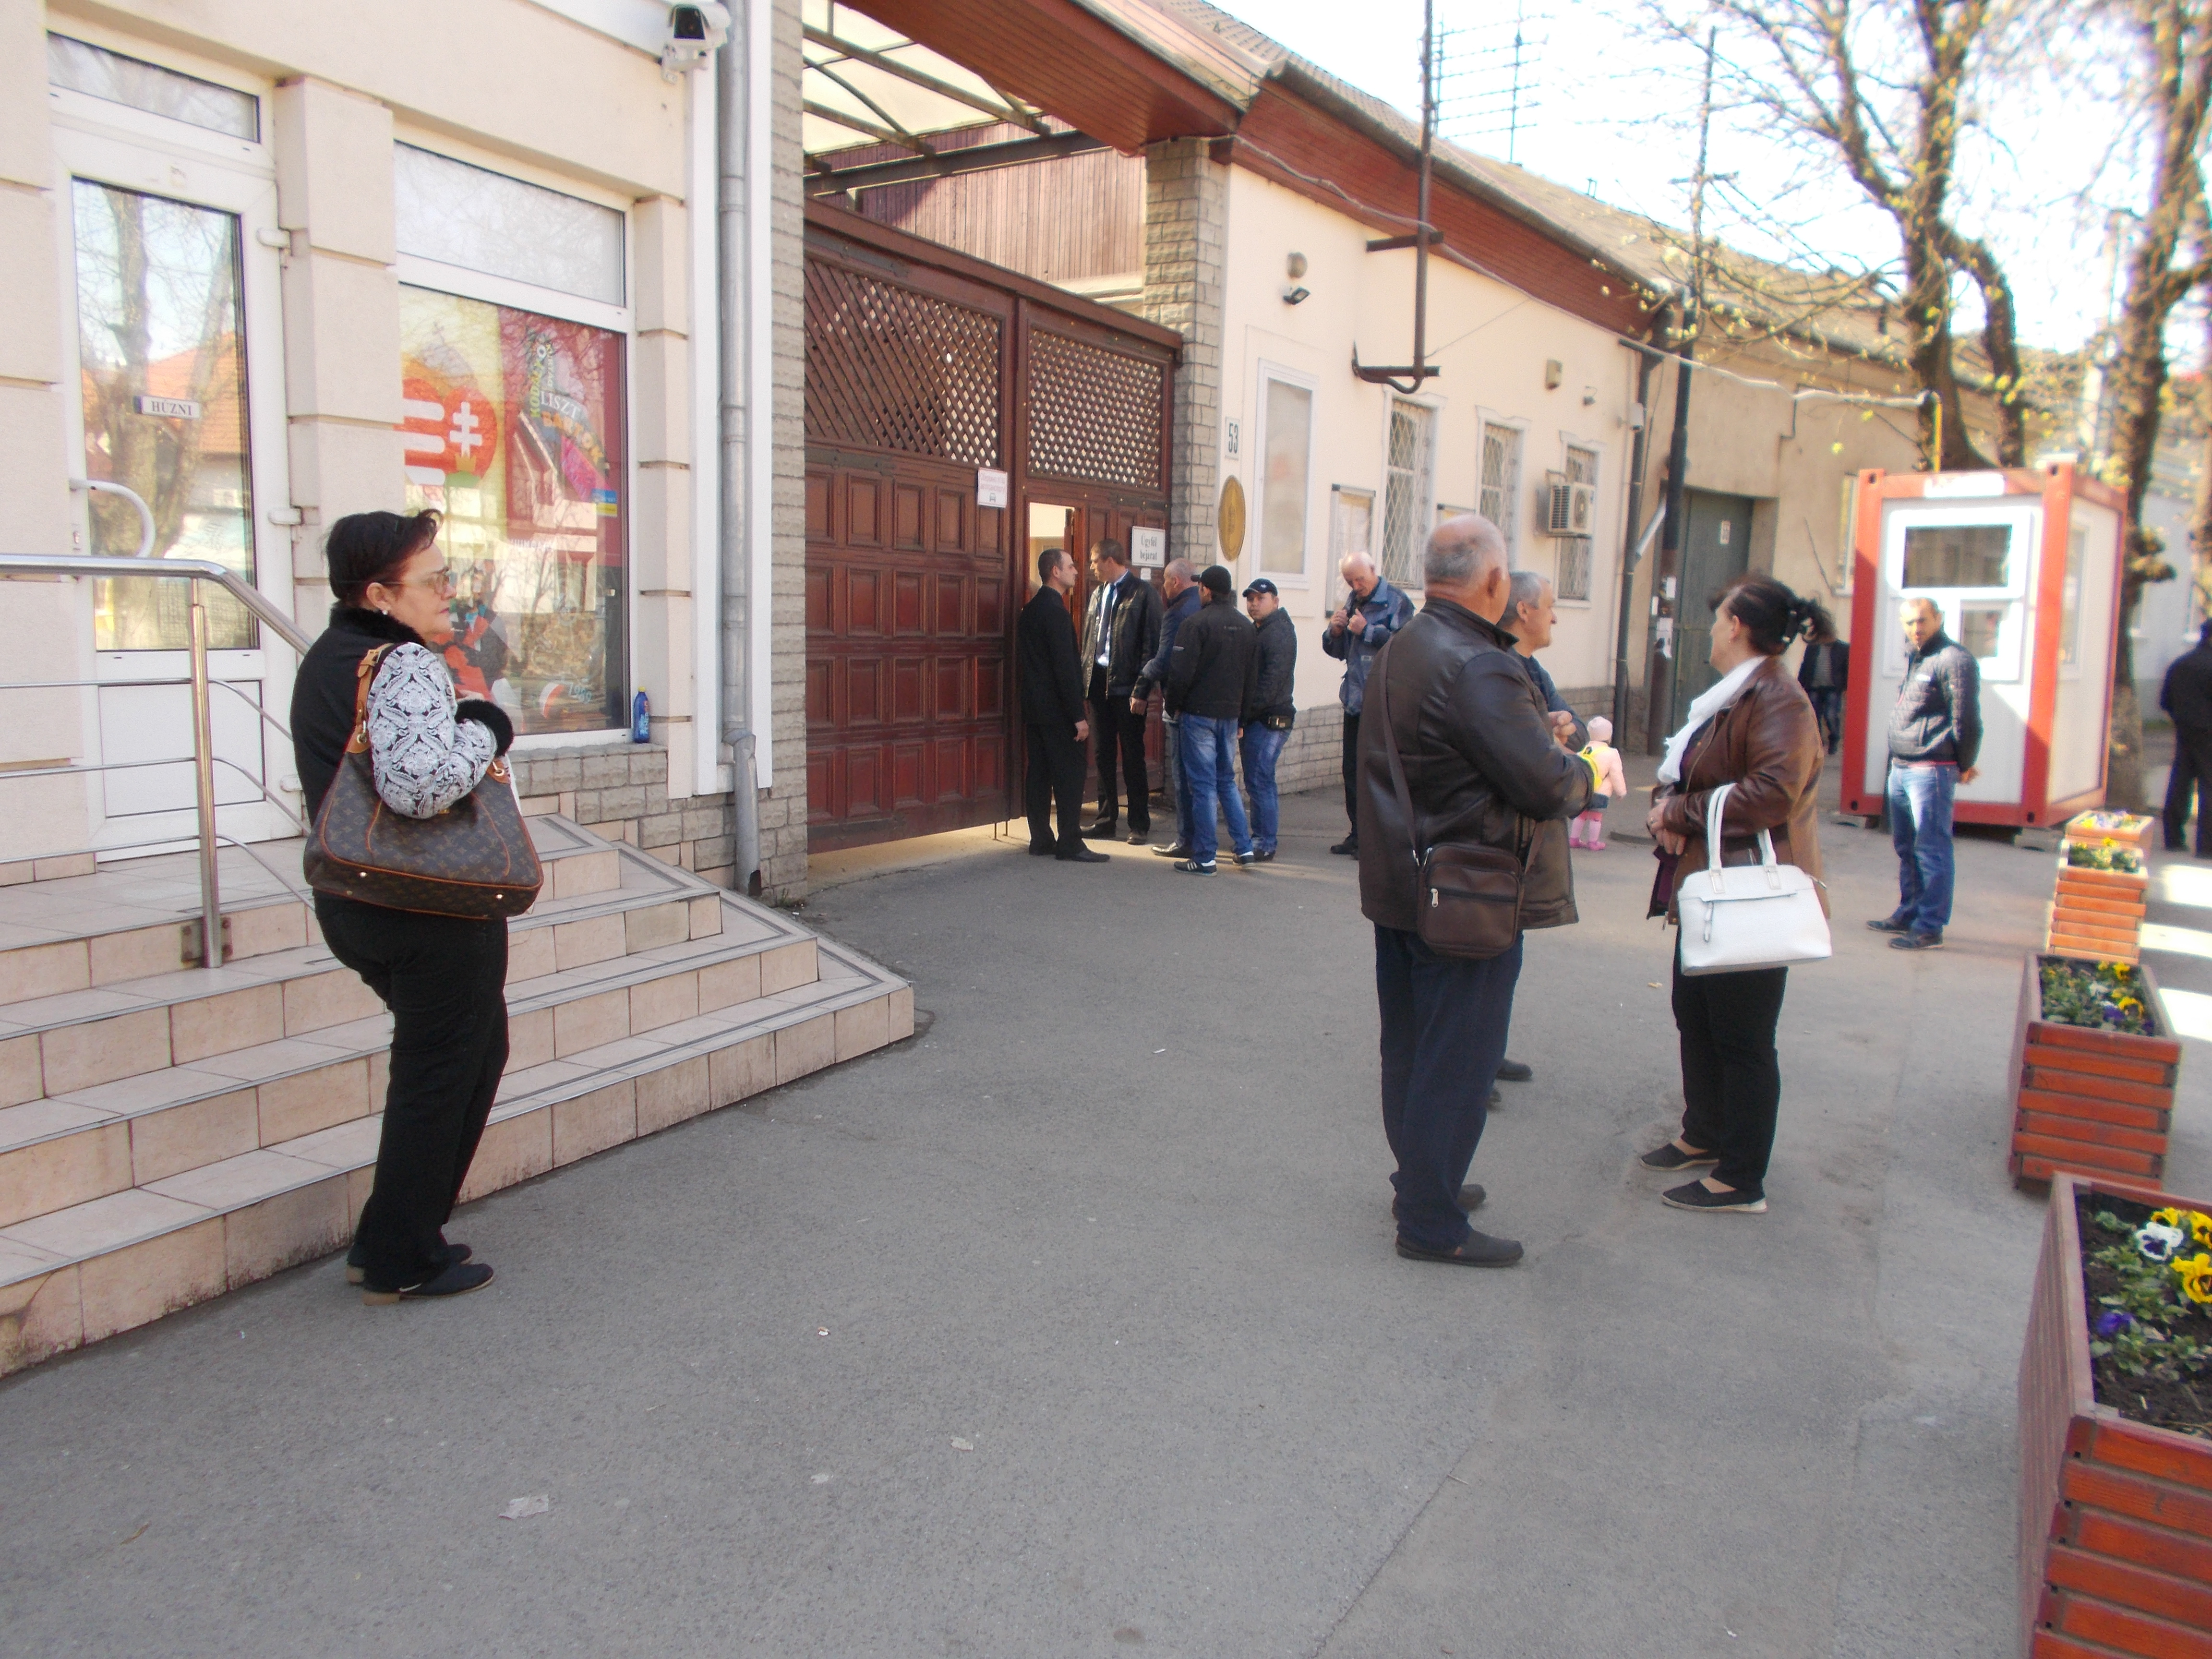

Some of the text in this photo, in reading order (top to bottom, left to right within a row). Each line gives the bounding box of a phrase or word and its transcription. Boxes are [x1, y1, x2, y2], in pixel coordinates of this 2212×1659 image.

[151, 399, 192, 416] HÚZNI
[541, 391, 581, 419] LISZT
[1228, 423, 1238, 454] 53
